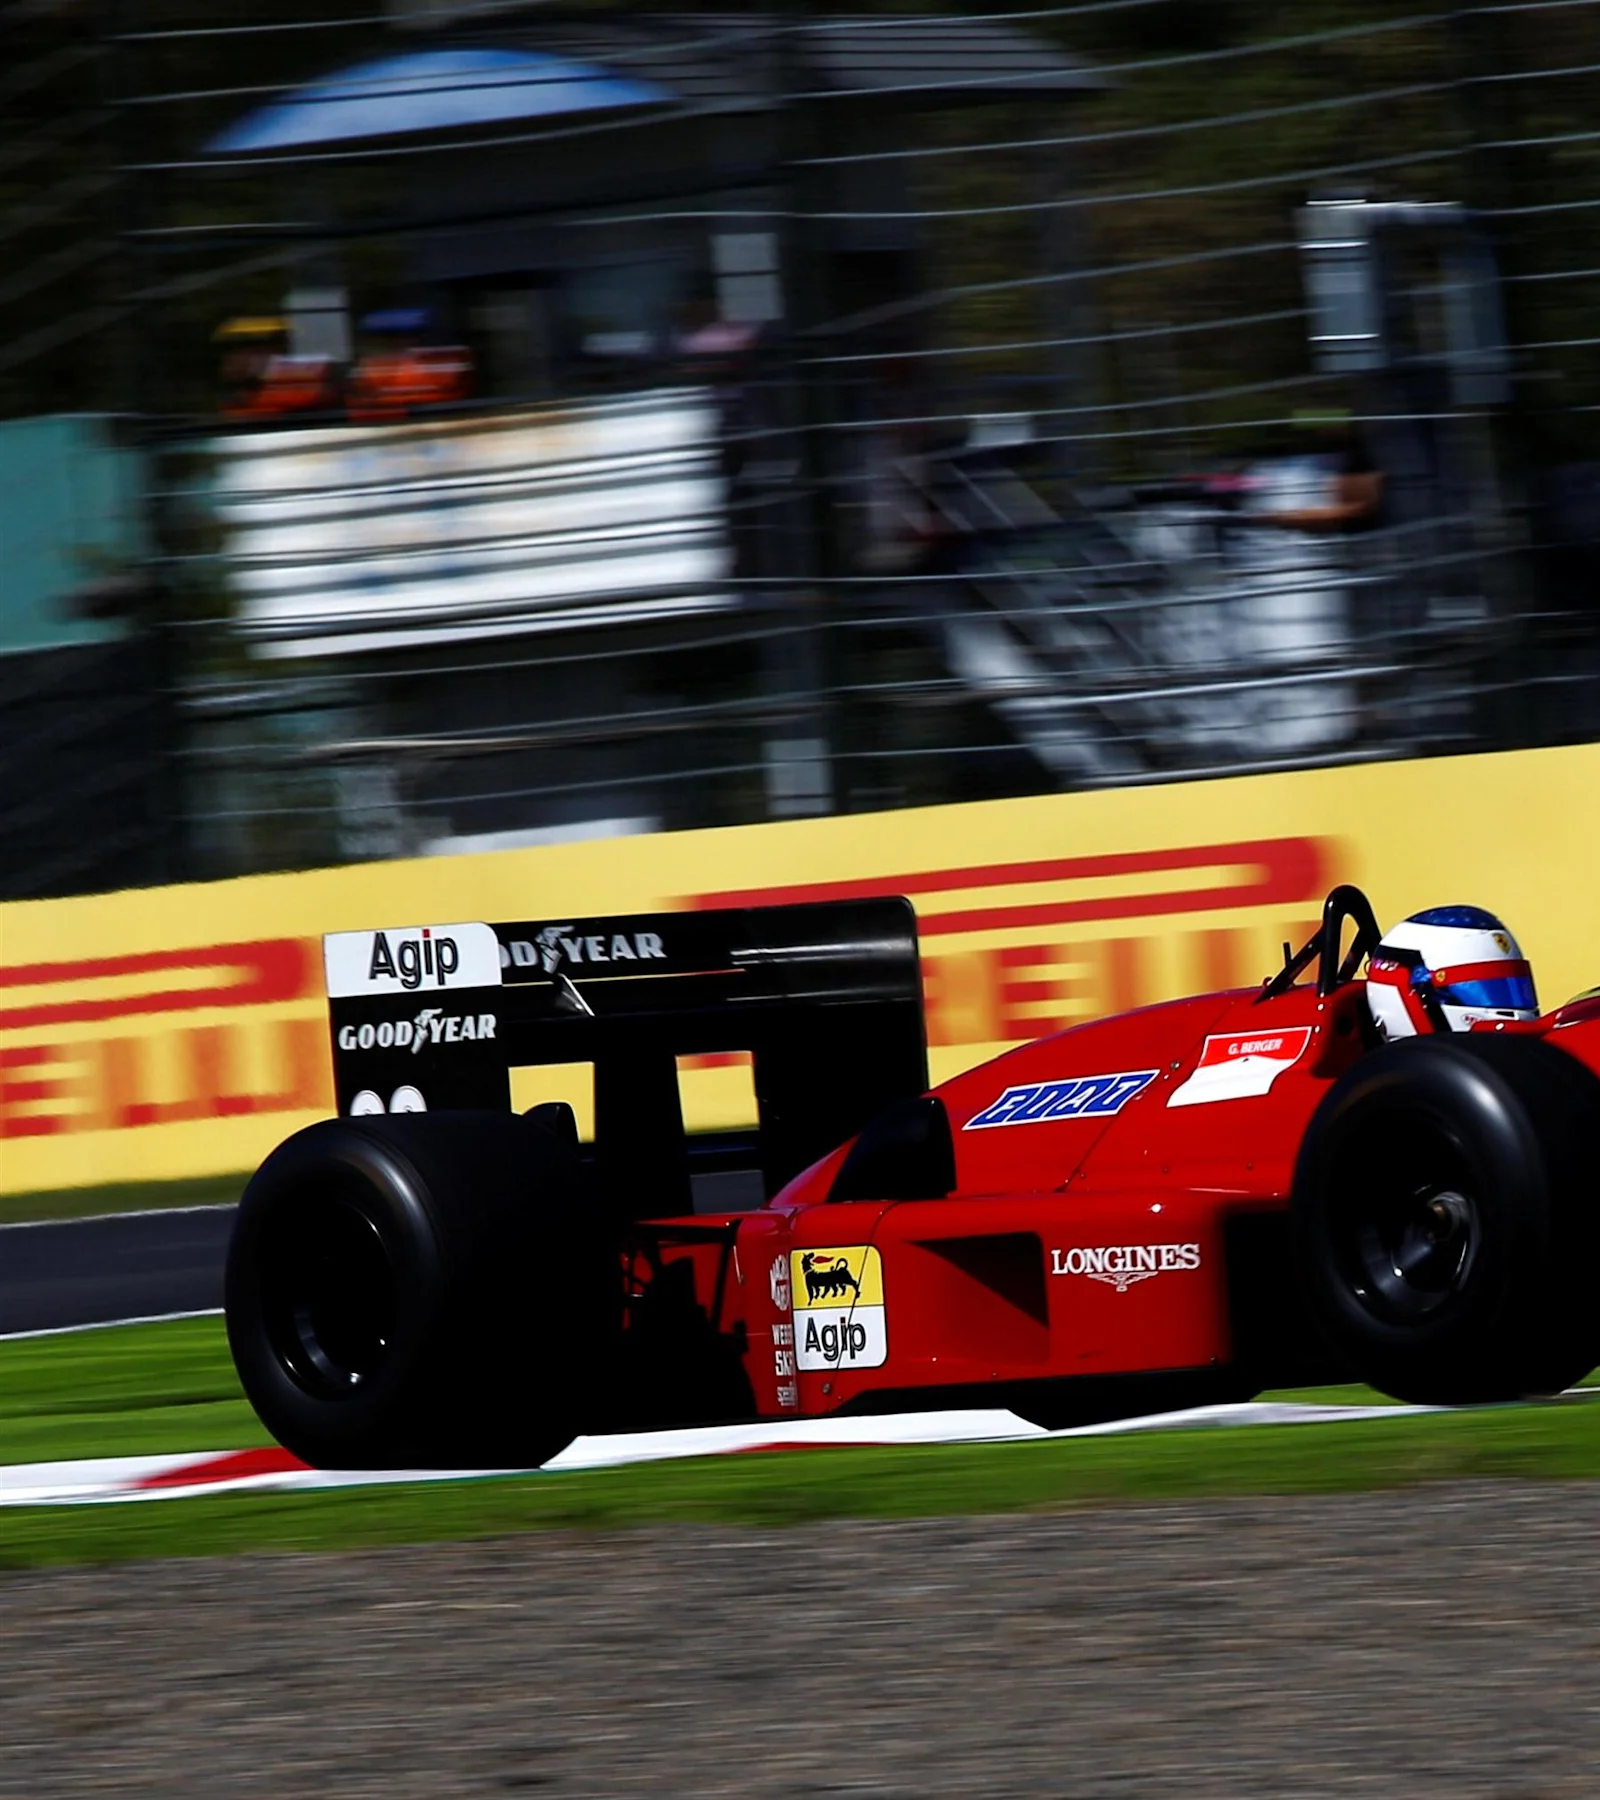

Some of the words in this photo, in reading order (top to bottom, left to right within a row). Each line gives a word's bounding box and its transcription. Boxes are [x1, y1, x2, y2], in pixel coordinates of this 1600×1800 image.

[368, 928, 459, 990] Agip
[338, 1010, 498, 1053] GOODYEAR
[1240, 1038, 1284, 1054] BERGER
[983, 1078, 1143, 1121] FIAT
[1051, 1243, 1201, 1275] LONGINES
[804, 1316, 867, 1362] Agip
